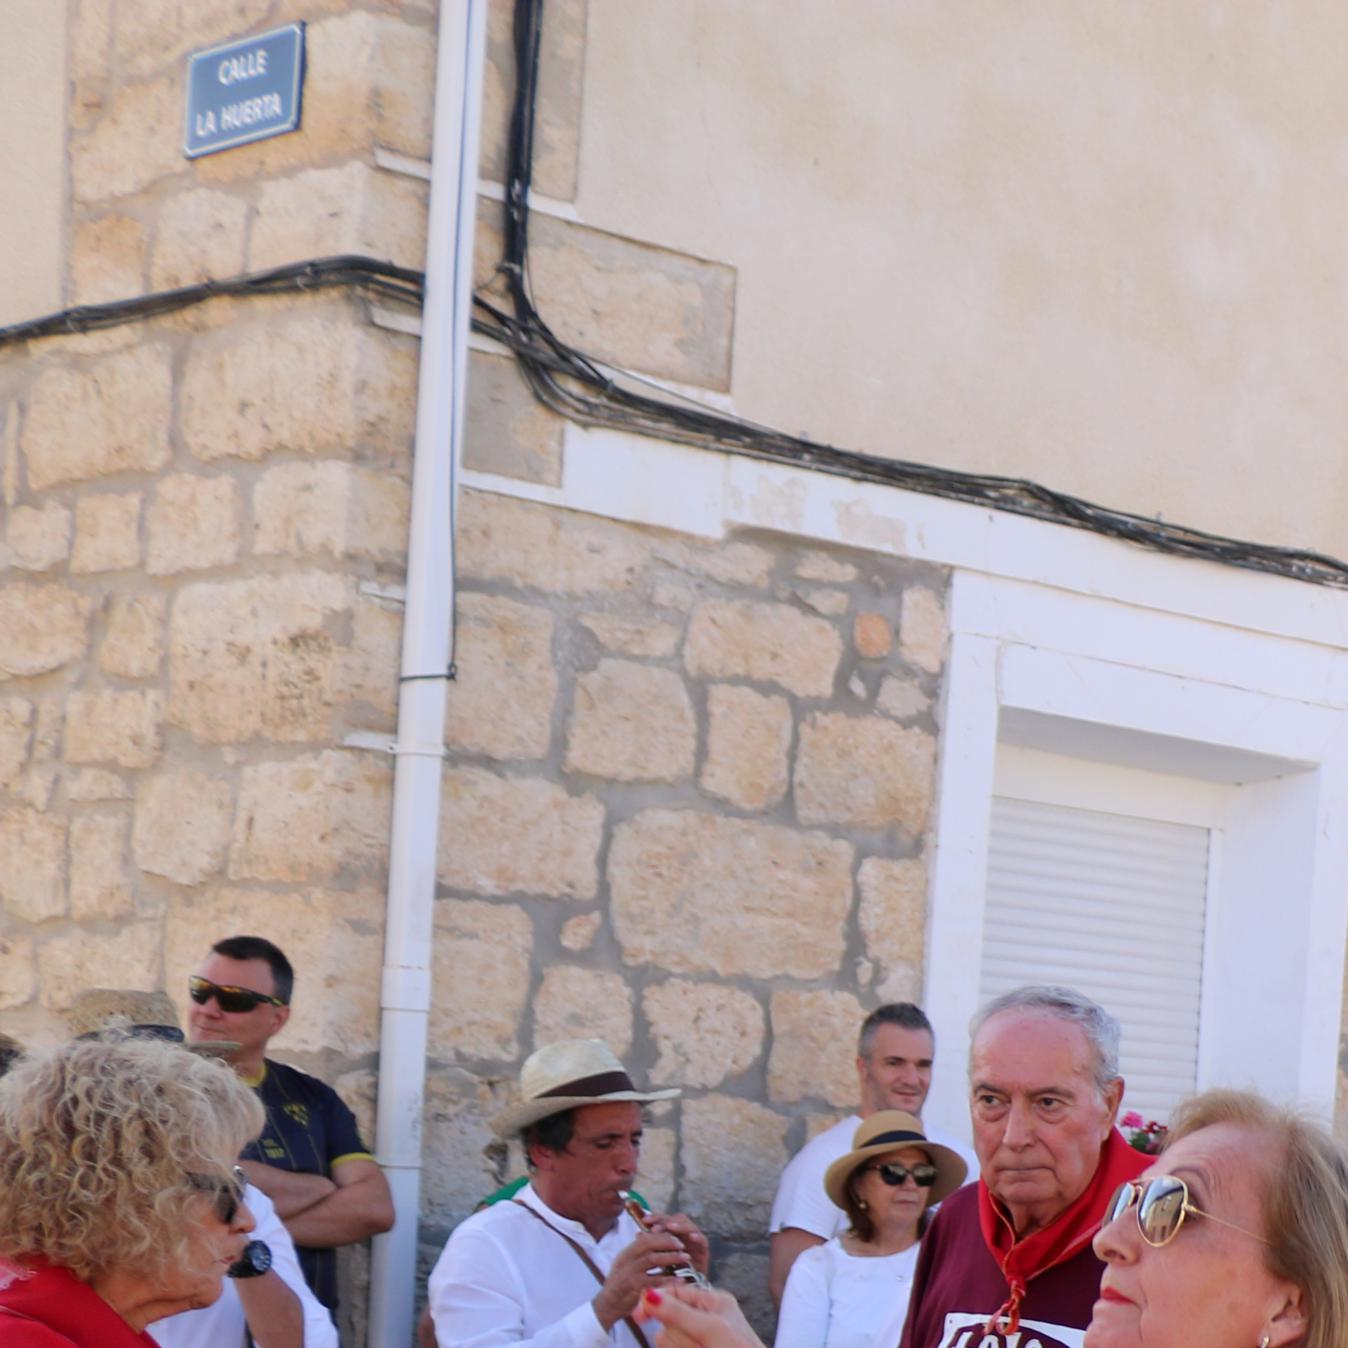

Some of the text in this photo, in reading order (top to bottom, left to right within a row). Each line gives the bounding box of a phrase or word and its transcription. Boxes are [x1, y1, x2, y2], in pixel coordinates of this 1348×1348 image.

[219, 49, 268, 86] CALLE
[196, 92, 282, 136] LA HUERTA
